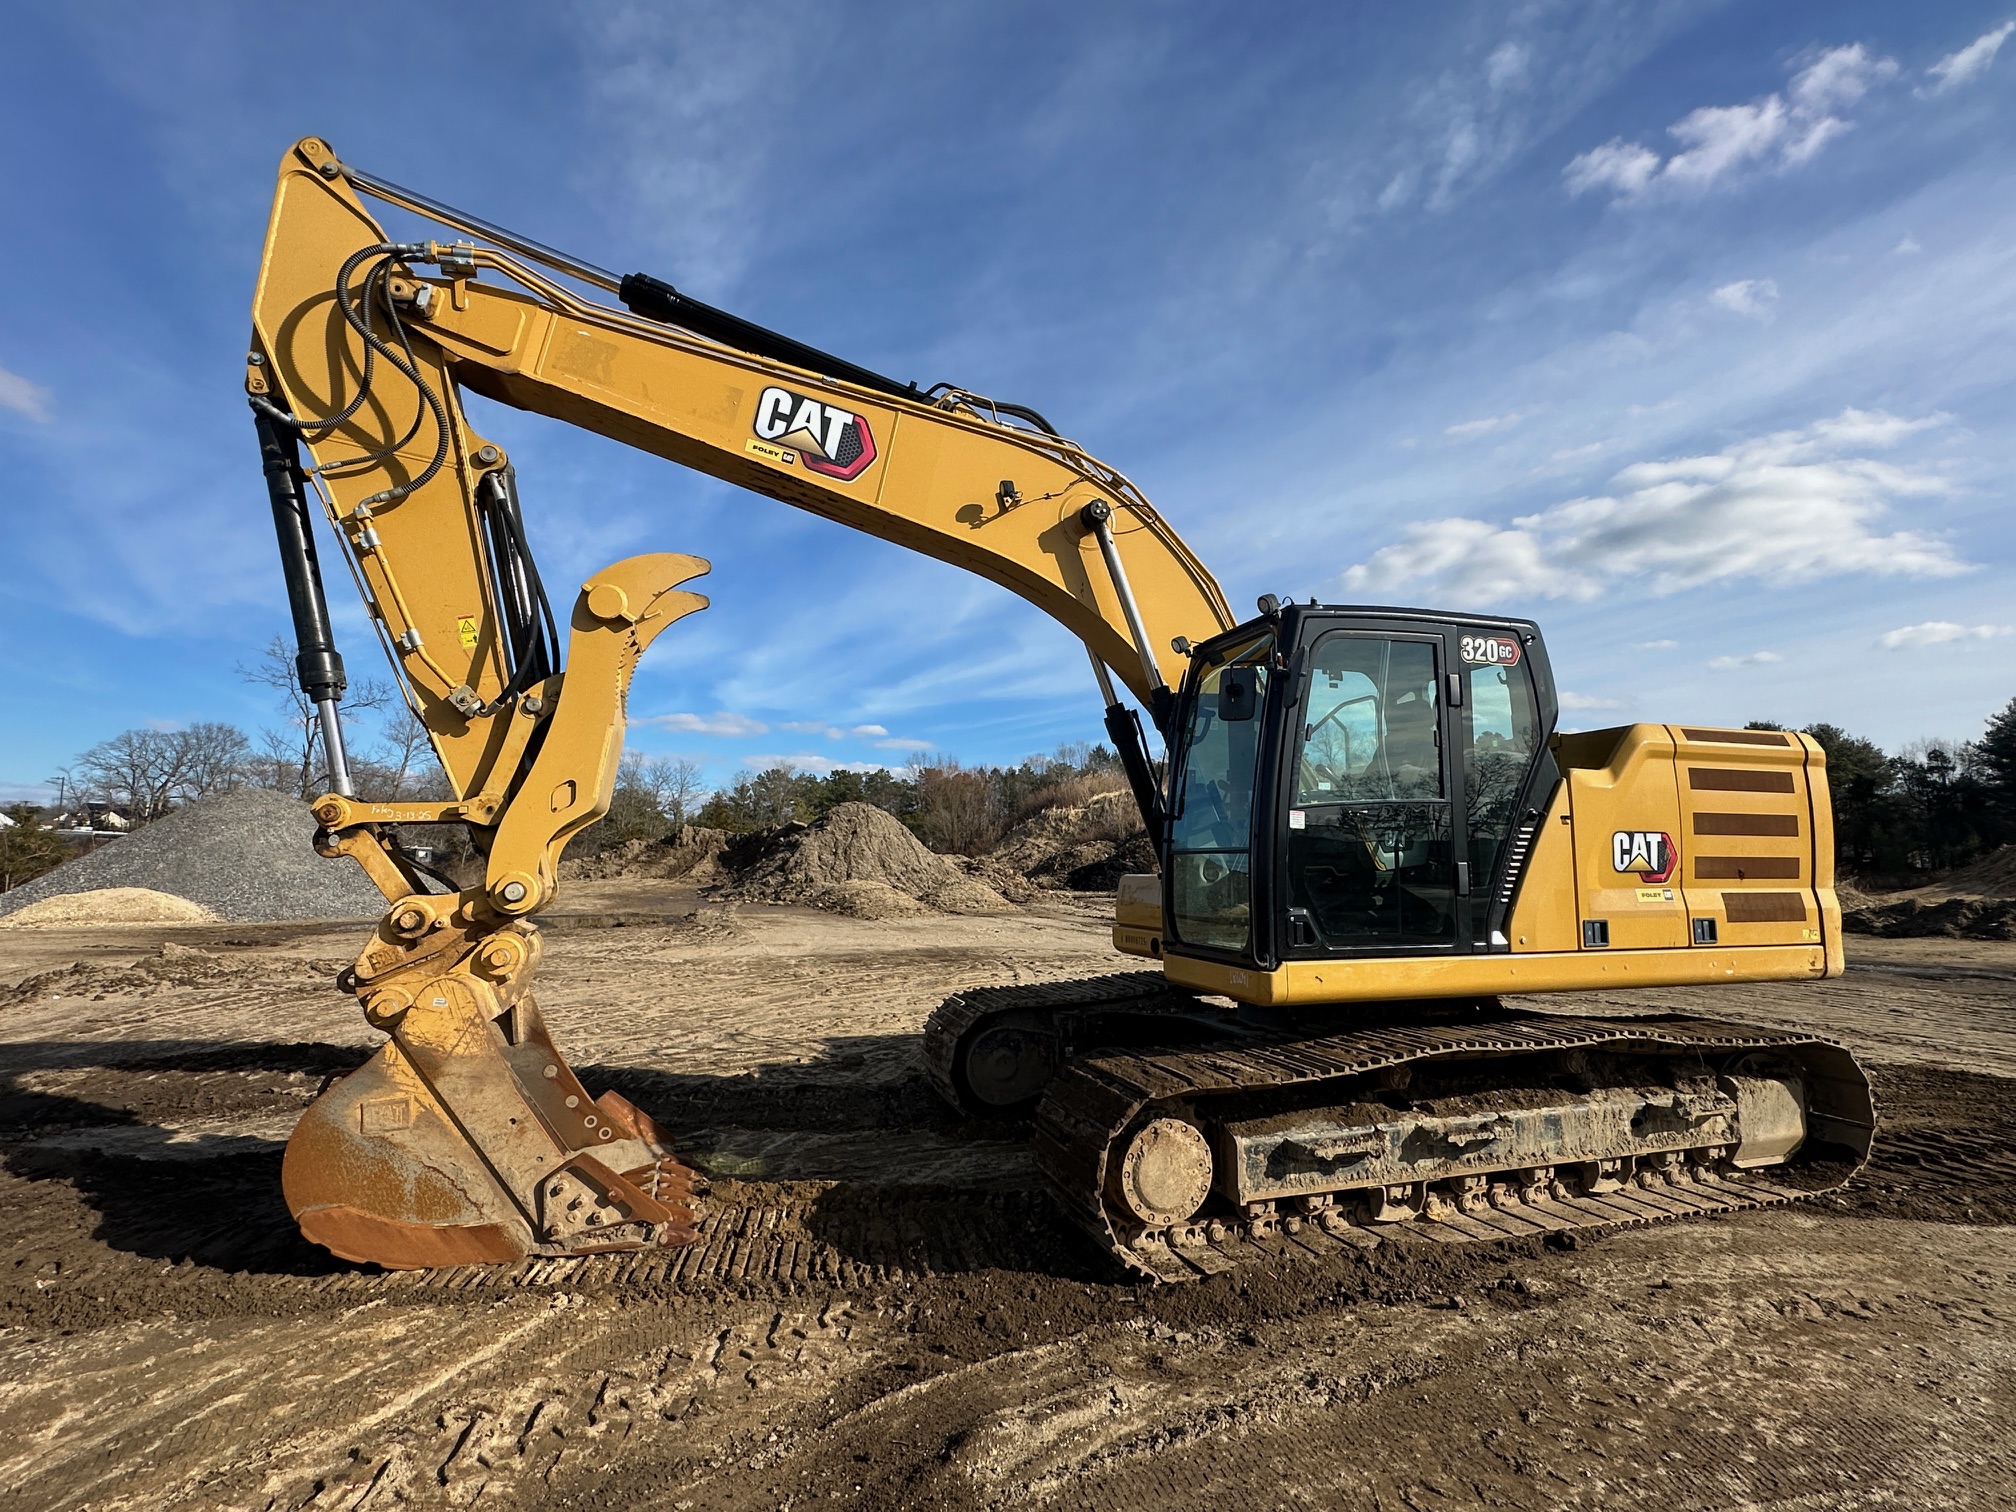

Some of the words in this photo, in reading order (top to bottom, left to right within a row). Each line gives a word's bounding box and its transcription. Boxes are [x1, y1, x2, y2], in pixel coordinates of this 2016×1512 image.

[755, 387, 854, 461] CAT
[752, 444, 780, 457] FOLEY
[1462, 637, 1499, 662] 320
[1498, 645, 1512, 658] GC
[1613, 832, 1662, 871] CAT
